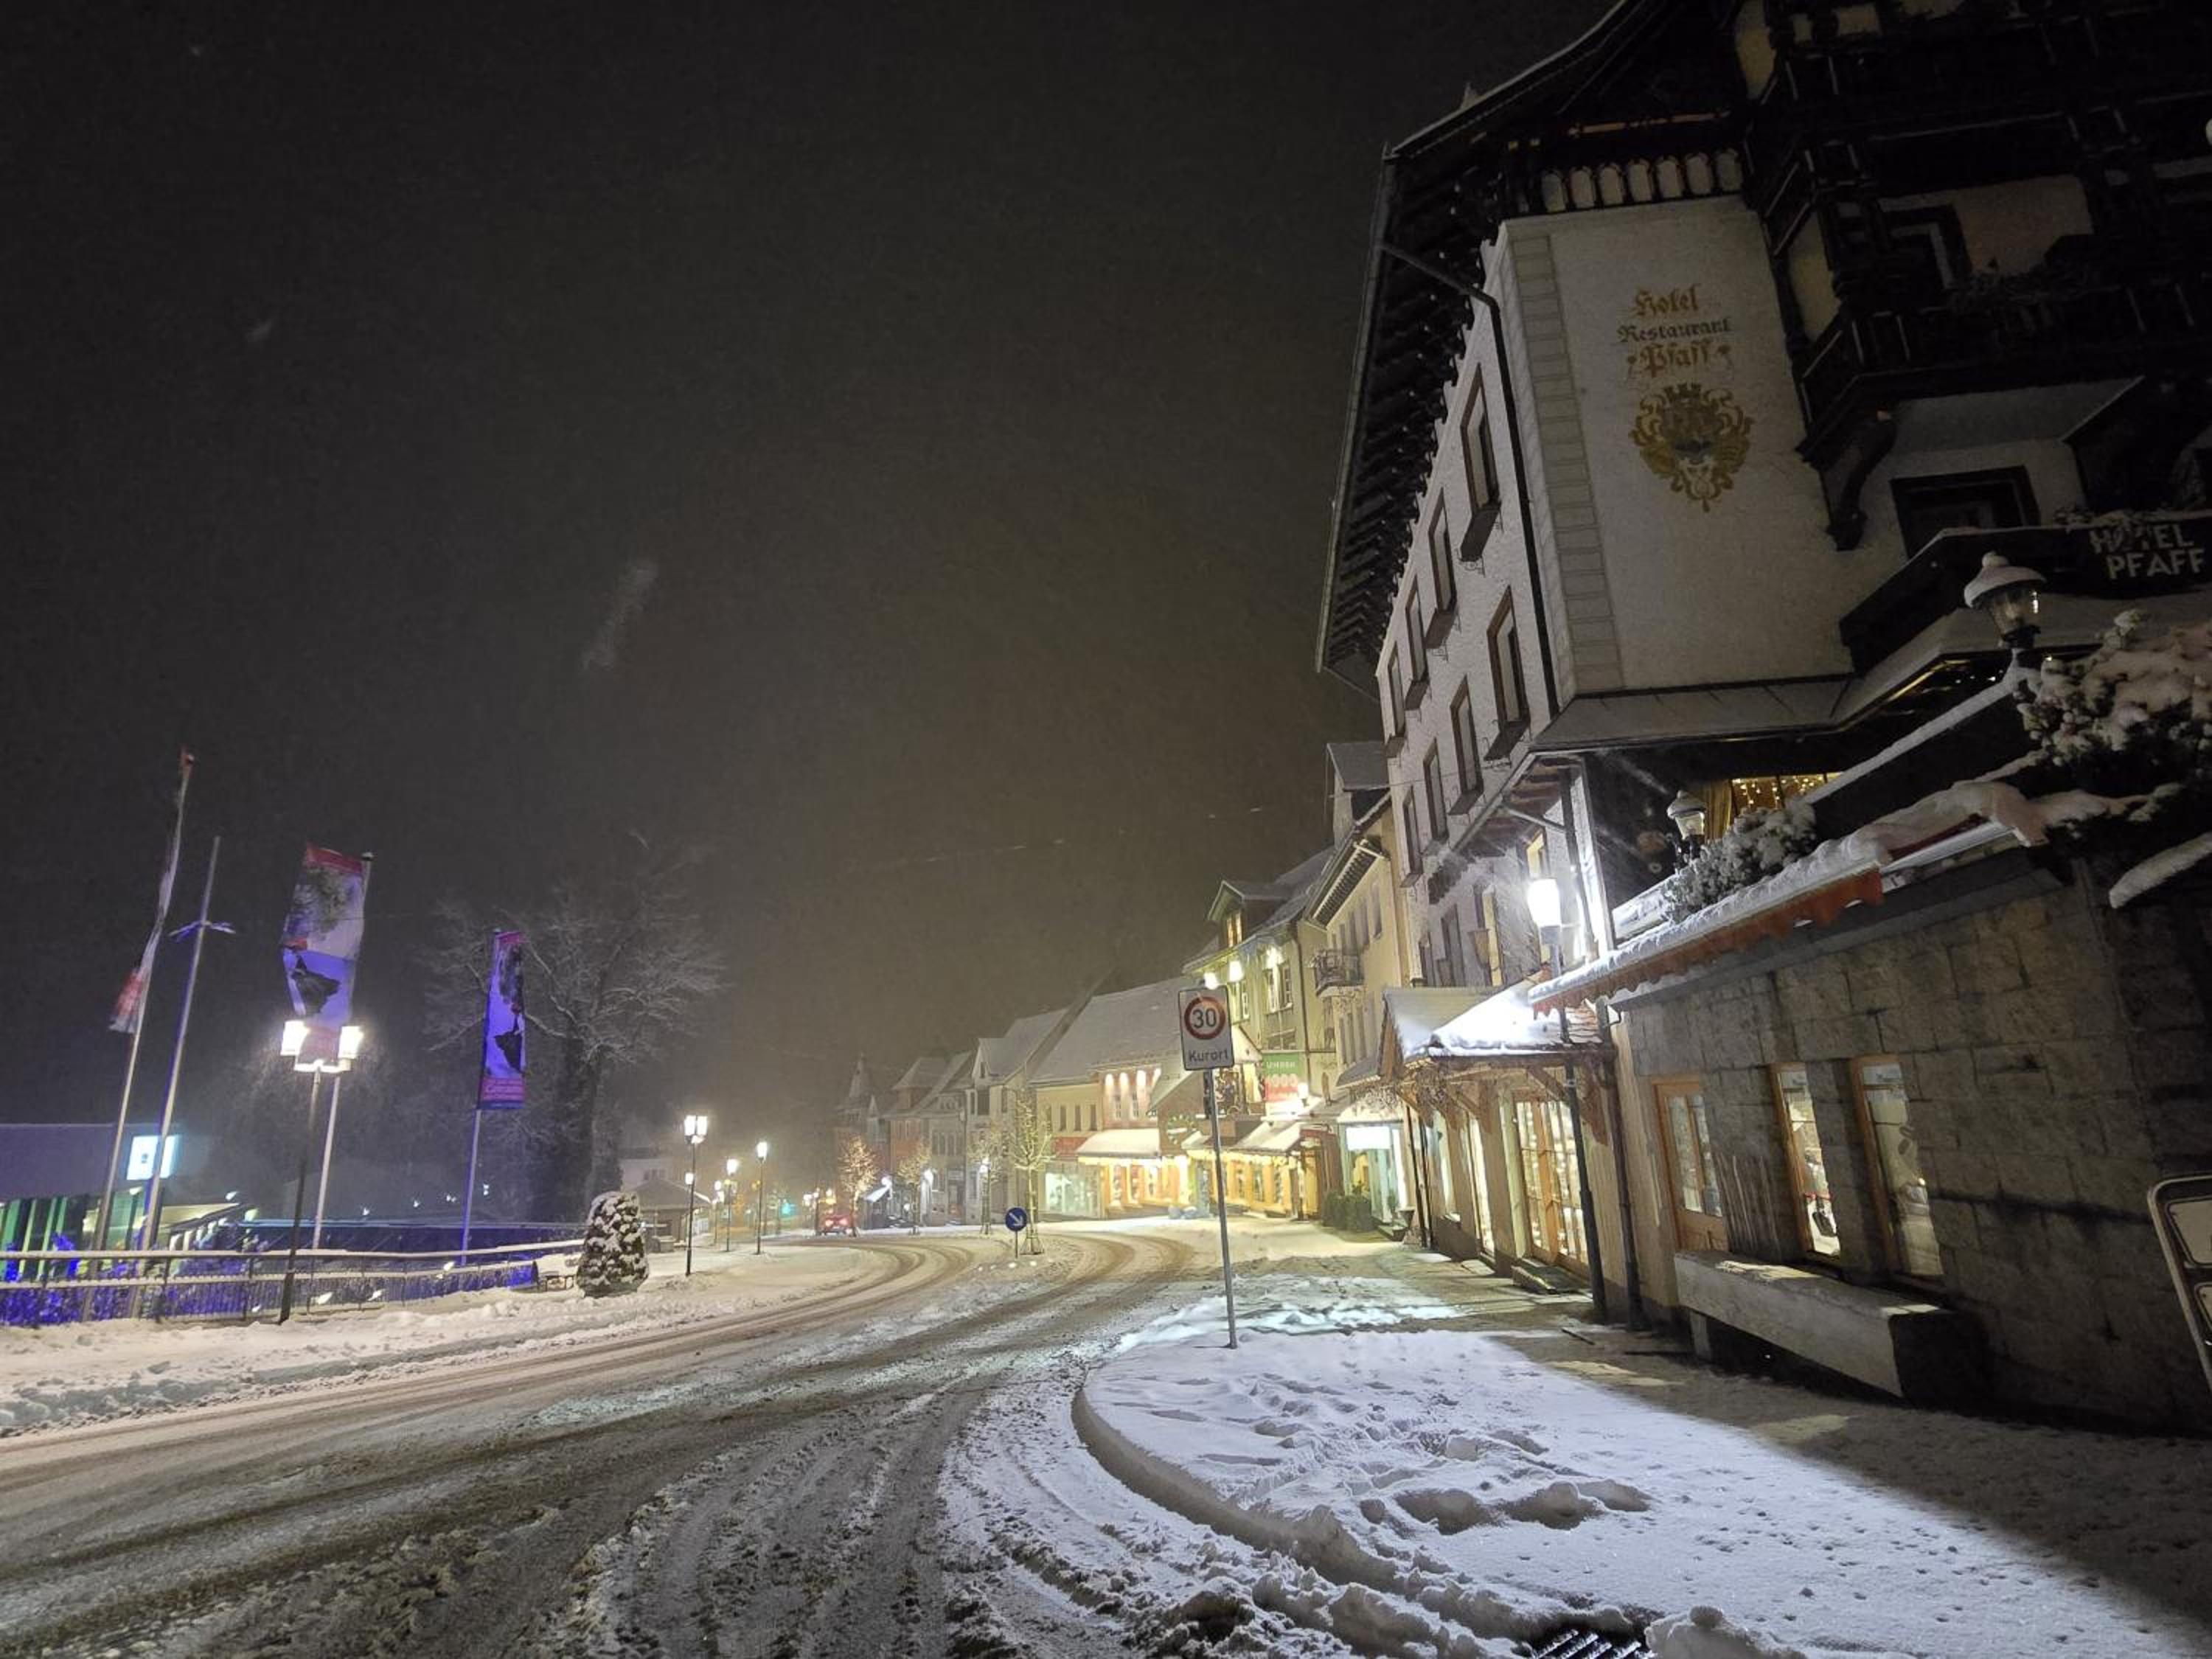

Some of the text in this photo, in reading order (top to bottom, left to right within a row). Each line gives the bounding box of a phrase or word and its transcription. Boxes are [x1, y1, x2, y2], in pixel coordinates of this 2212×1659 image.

[1633, 284, 1700, 316] Hotel
[1617, 318, 1731, 343] Restaurant
[2105, 549, 2205, 580] PFAFF
[1192, 1008, 1217, 1029] 30
[1189, 1048, 1228, 1062] Kurort
